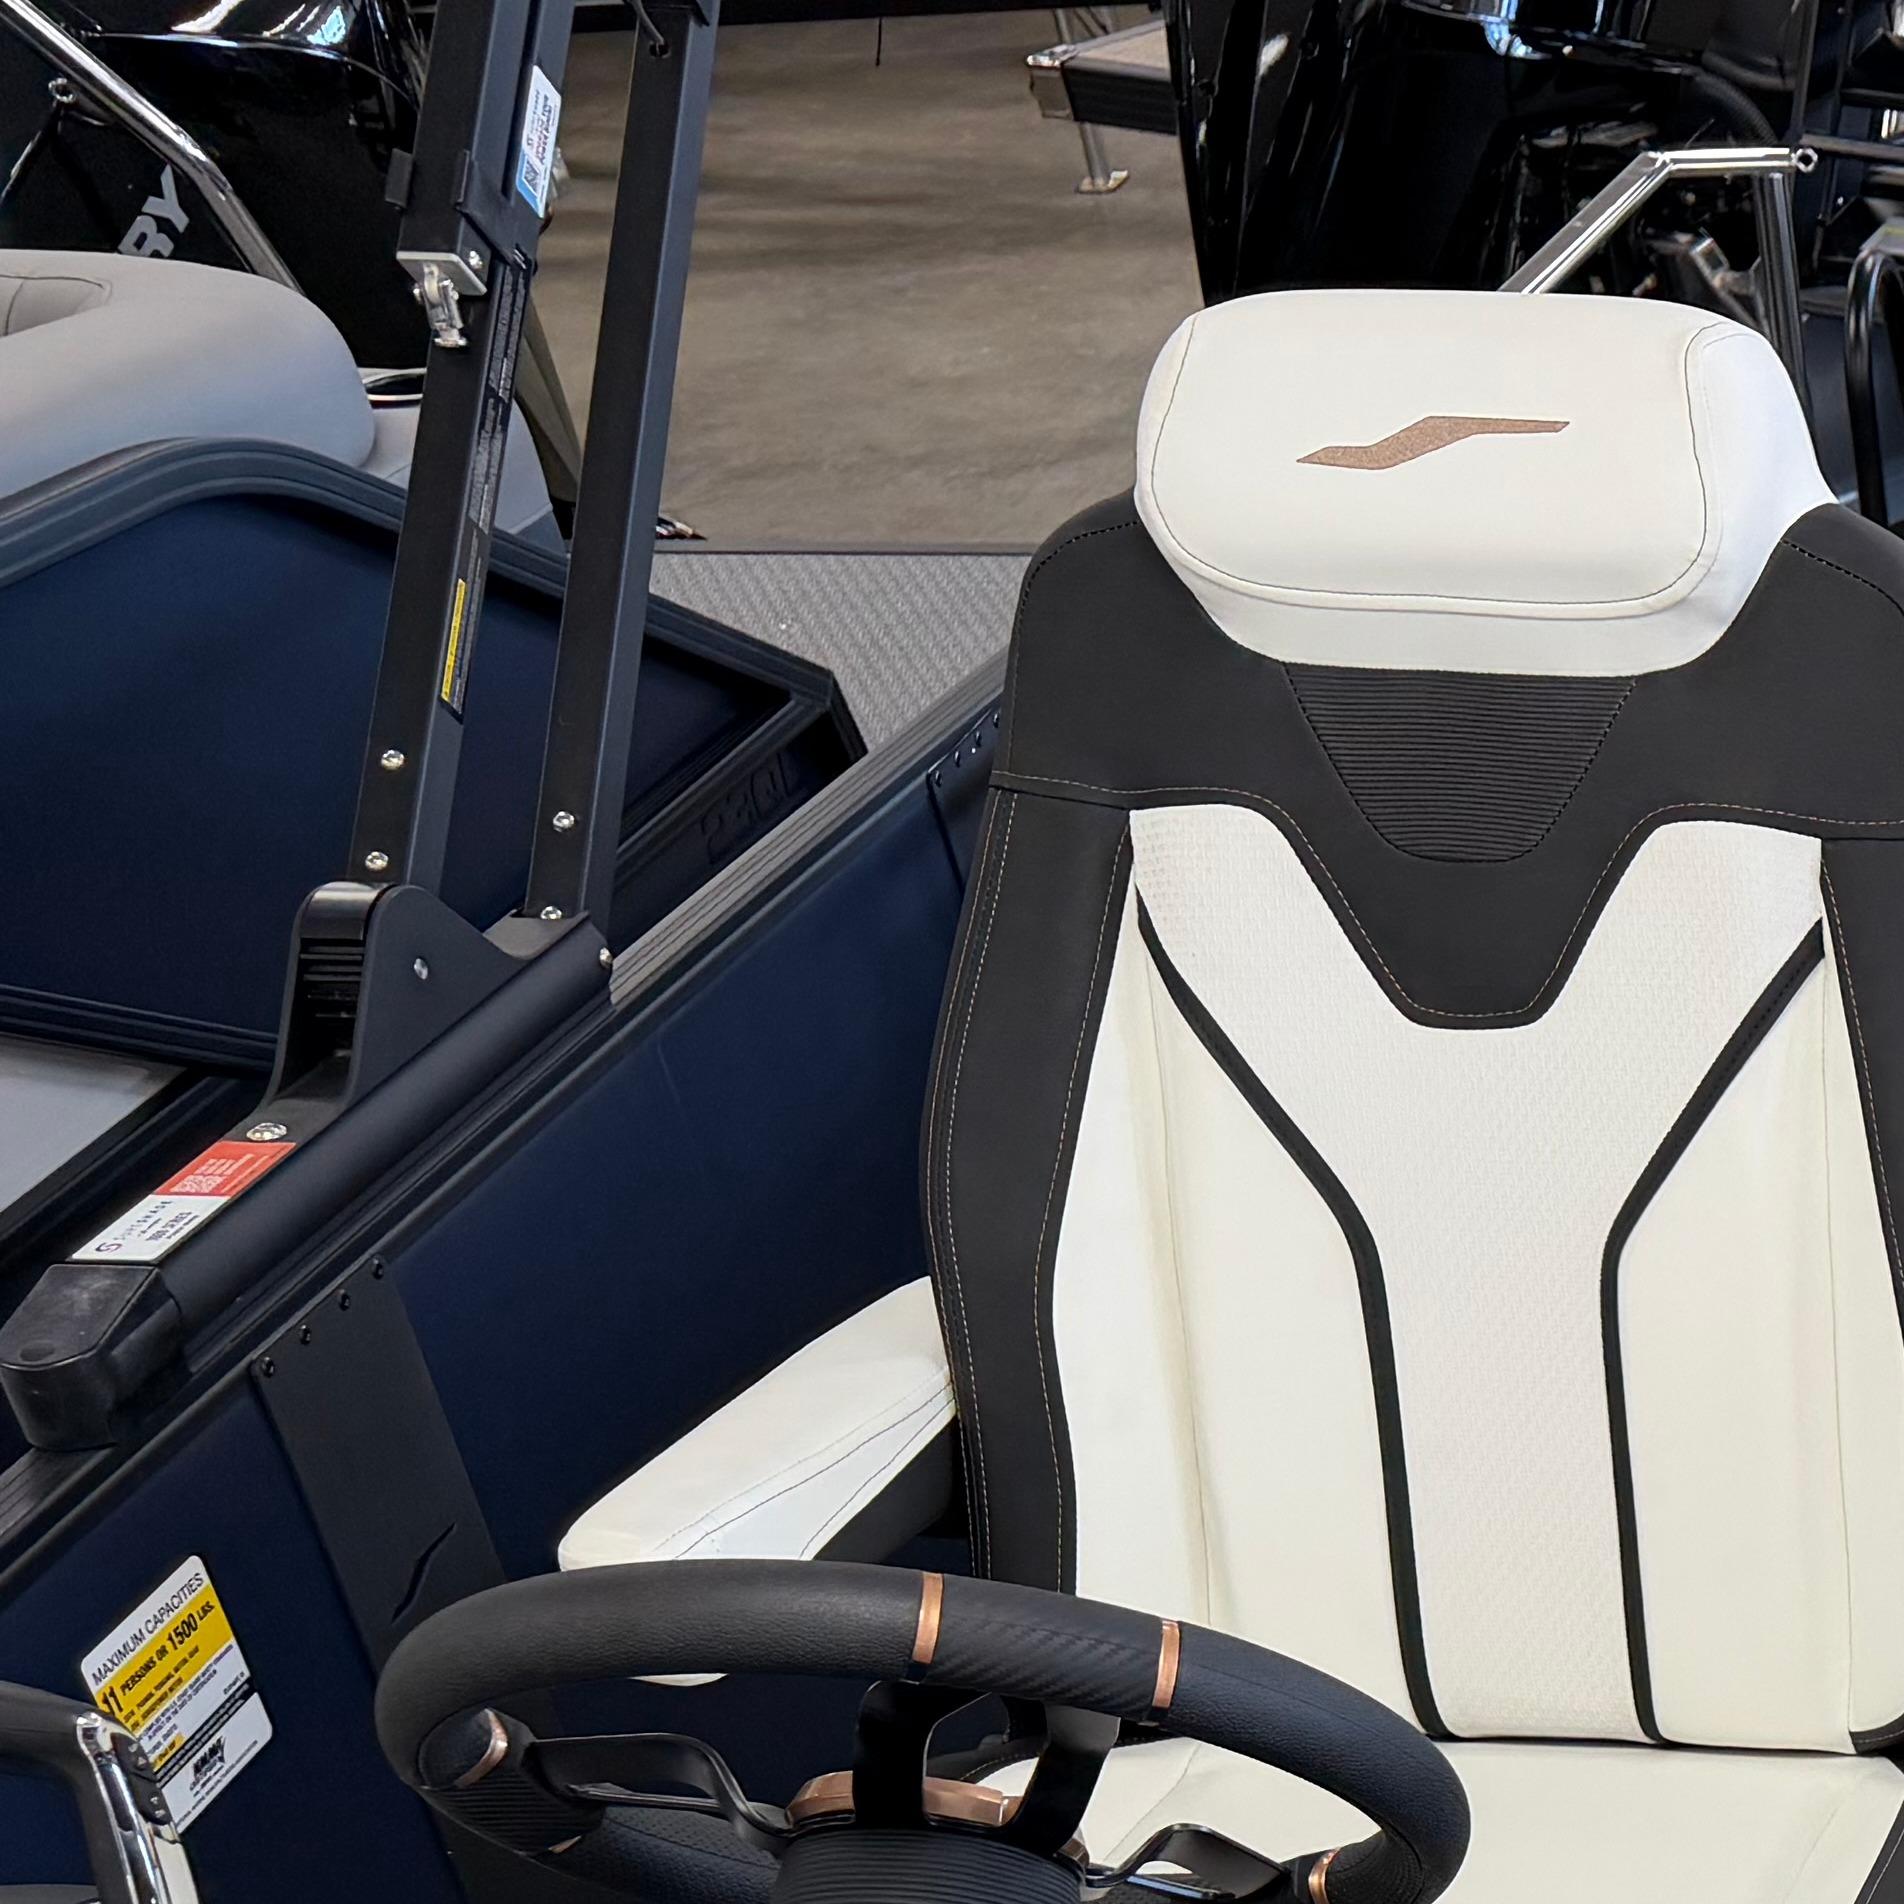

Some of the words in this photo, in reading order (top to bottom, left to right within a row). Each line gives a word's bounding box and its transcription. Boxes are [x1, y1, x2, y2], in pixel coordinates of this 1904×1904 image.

[92, 1628, 147, 1686] MAXIMUM
[144, 1572, 204, 1634] CAPACITIES
[120, 1656, 157, 1696] PERSONS
[166, 1612, 198, 1651] 1500
